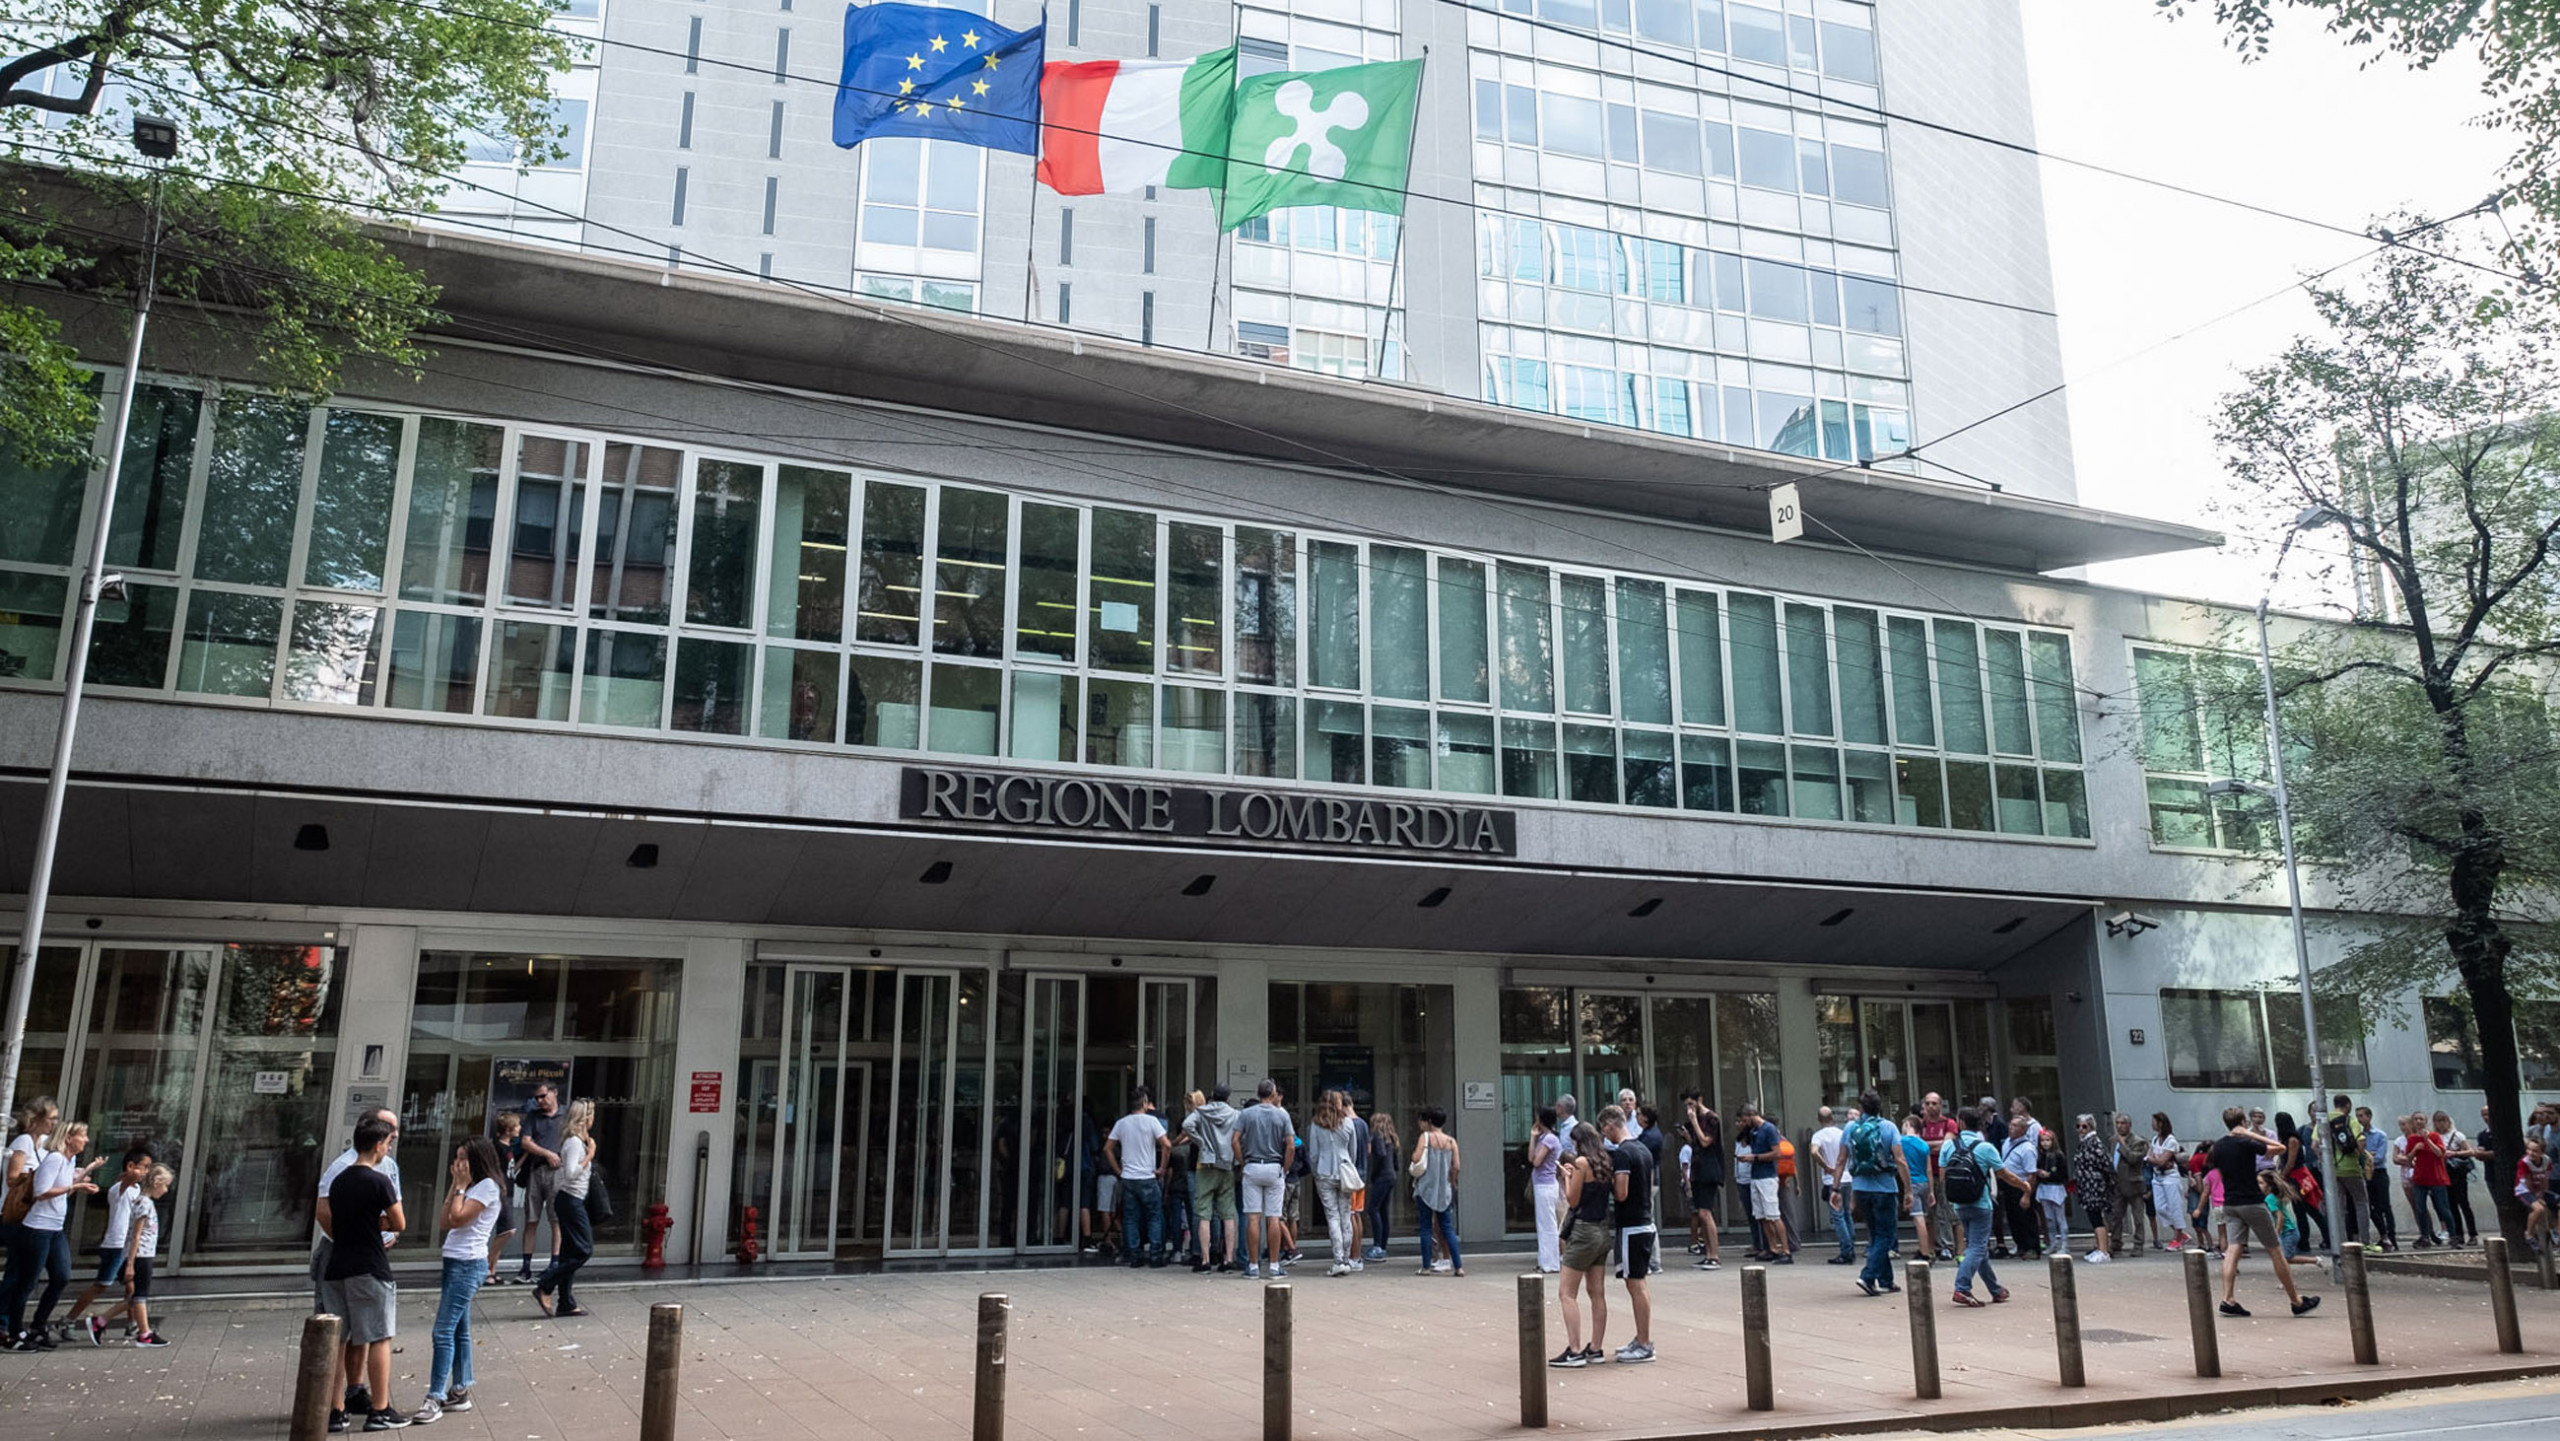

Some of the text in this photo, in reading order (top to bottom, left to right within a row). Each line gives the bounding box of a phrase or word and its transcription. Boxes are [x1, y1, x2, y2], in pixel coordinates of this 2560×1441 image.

[1777, 504, 1794, 524] 20
[920, 770, 1504, 854] REGIONE LOMBARDIA
